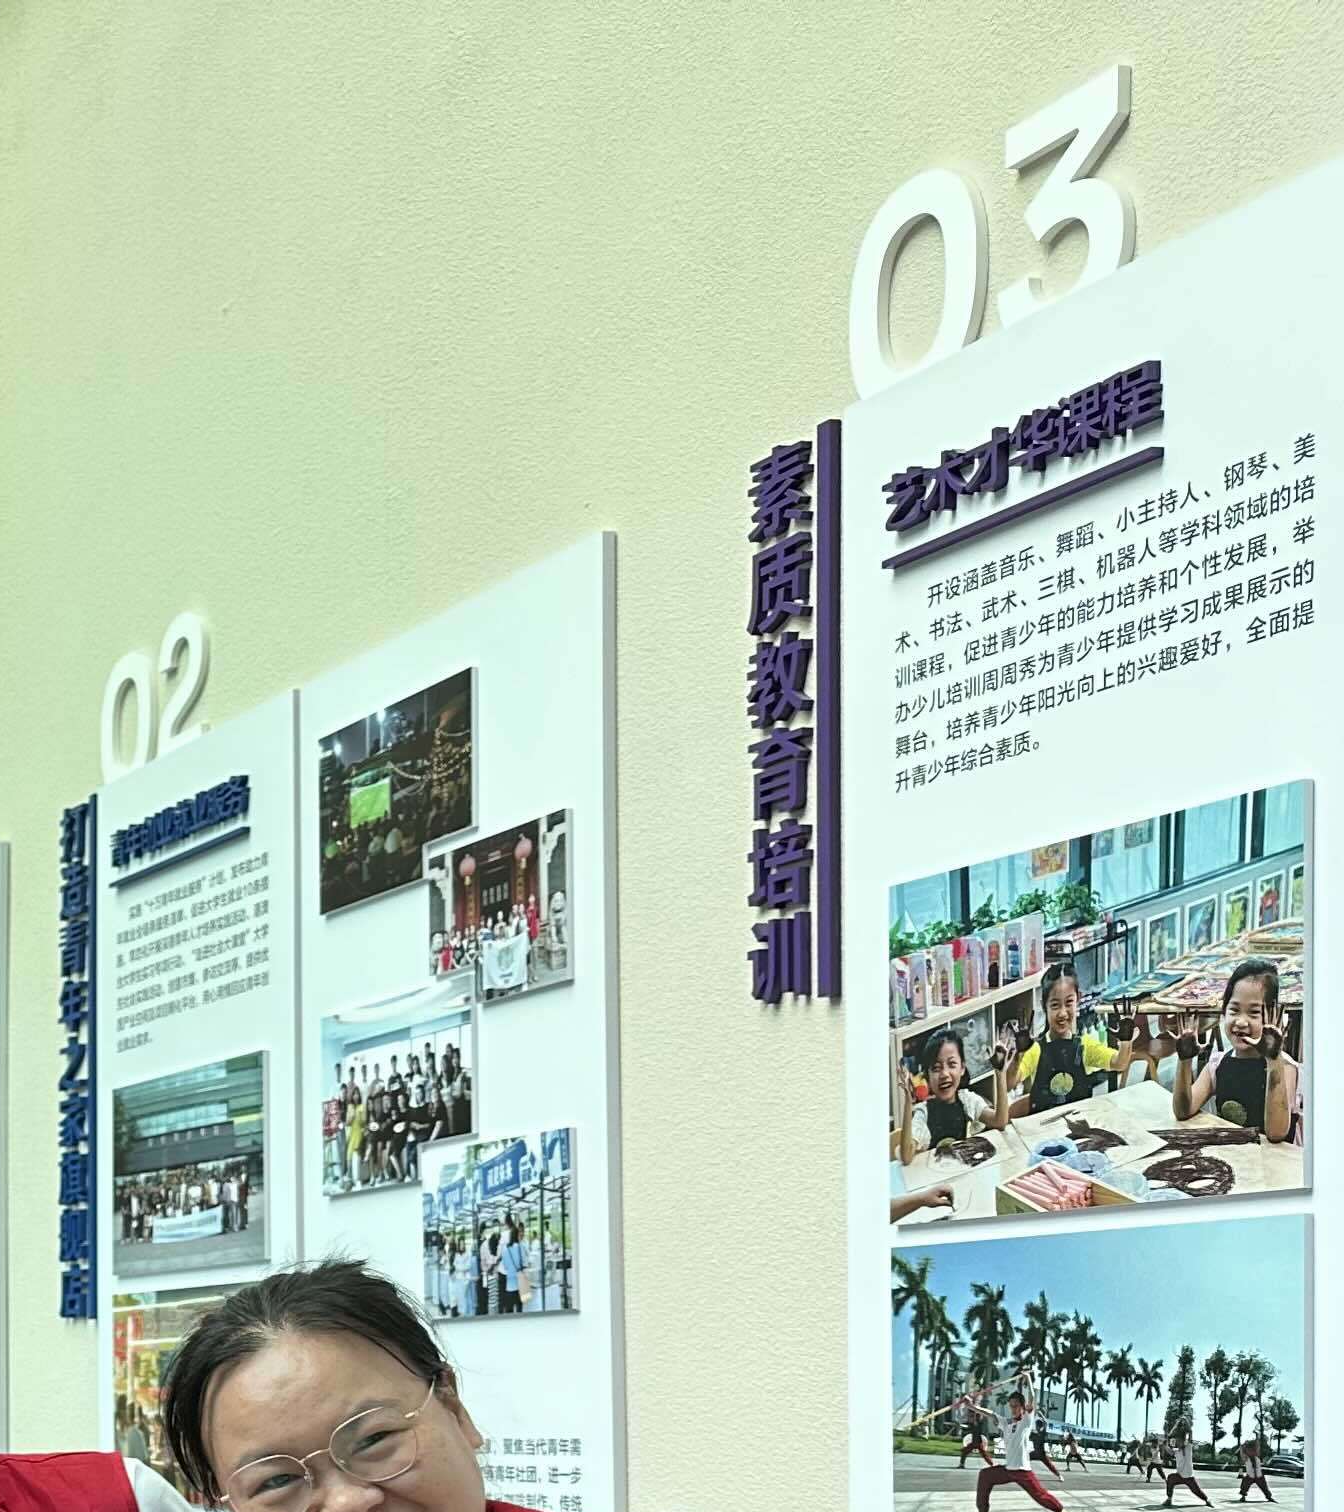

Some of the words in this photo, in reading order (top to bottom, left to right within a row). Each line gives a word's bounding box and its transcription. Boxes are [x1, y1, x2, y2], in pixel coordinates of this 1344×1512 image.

[849, 64, 1137, 400] 03
[882, 360, 1164, 534] 艺术才华课程
[101, 612, 211, 785] 02
[748, 441, 815, 1002] 素质教育培训
[894, 740, 1040, 793] 升青少年综合素质。
